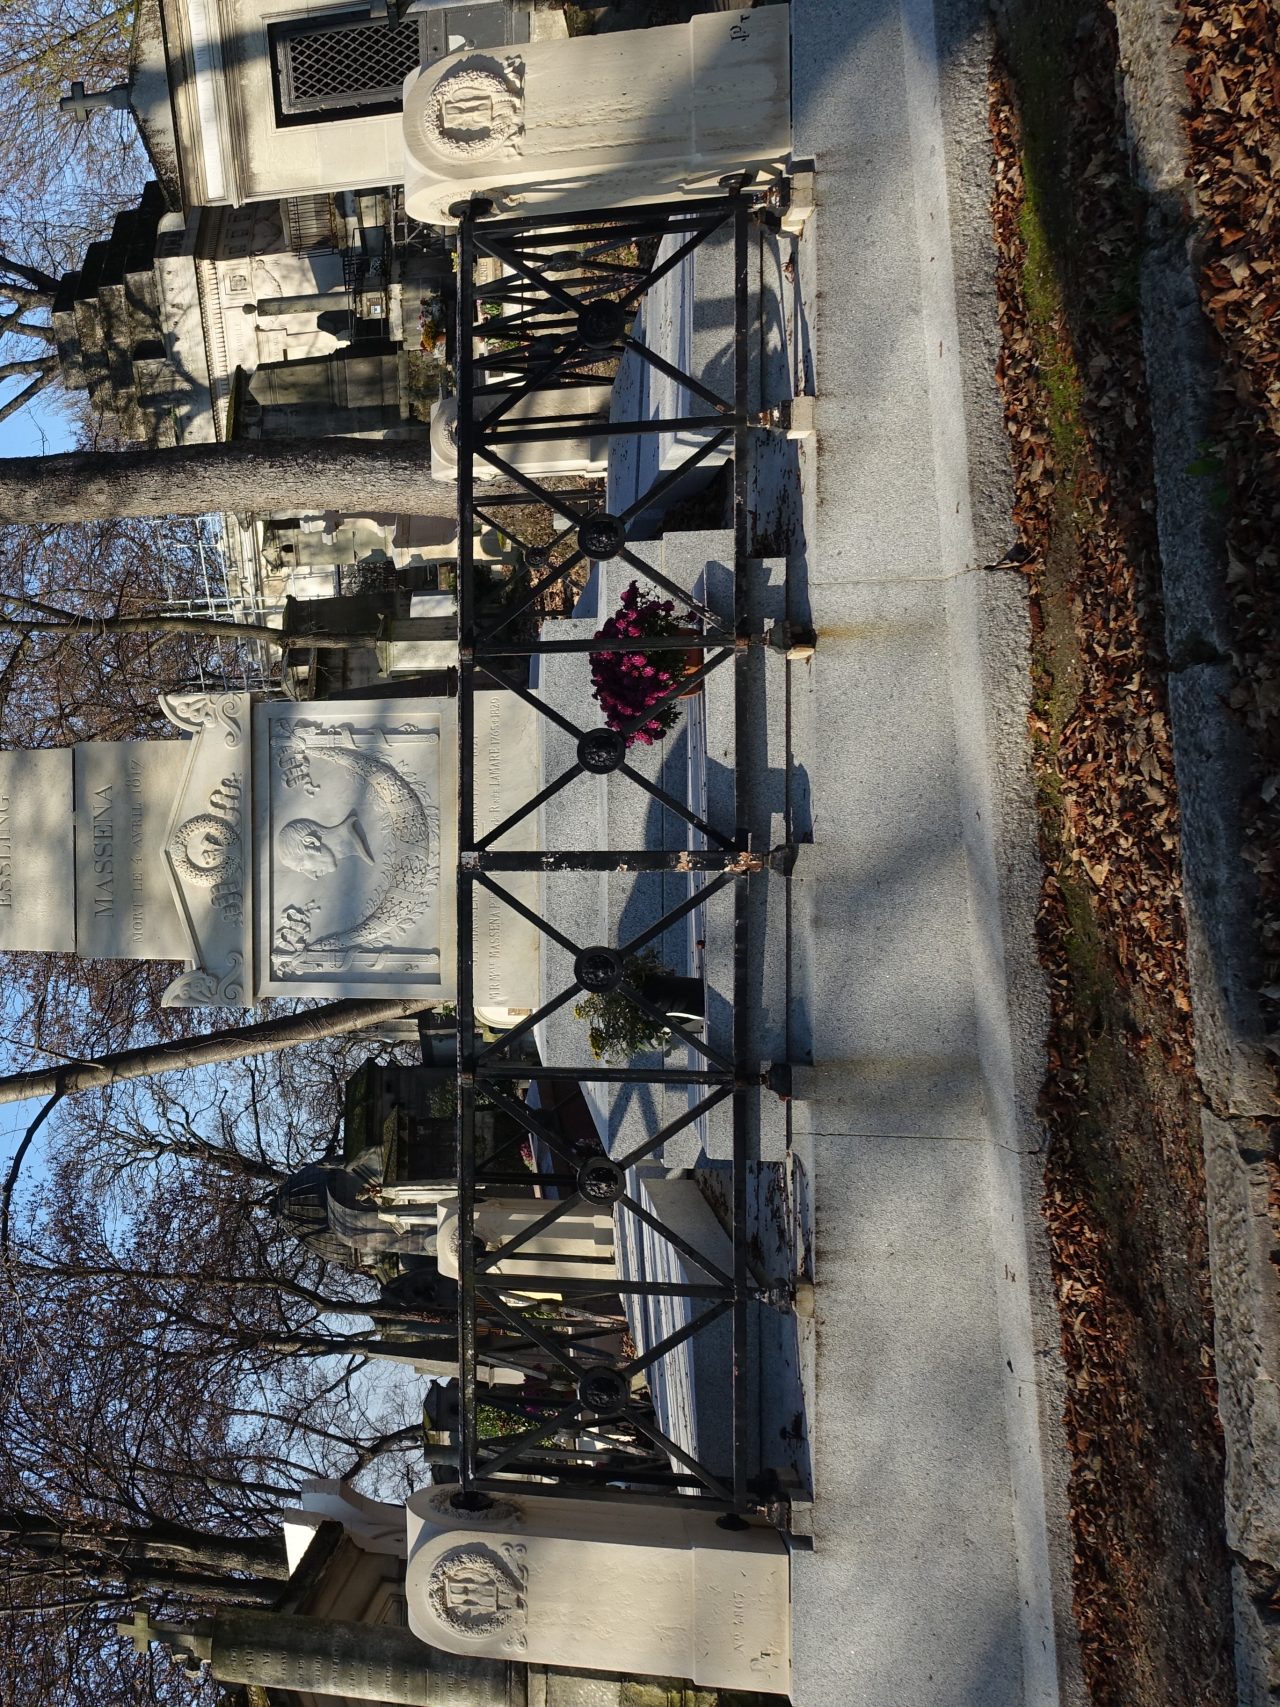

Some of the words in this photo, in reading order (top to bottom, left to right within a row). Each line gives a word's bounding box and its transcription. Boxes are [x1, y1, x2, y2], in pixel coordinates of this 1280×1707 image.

[127, 758, 144, 795] 1817
[488, 747, 501, 786] LAMARE
[131, 802, 144, 849] AVRIL
[93, 785, 115, 918] MASSENA
[128, 856, 144, 865] 4
[132, 871, 144, 893] LE
[132, 899, 144, 943] MORT
[488, 910, 501, 958] MASSENA
